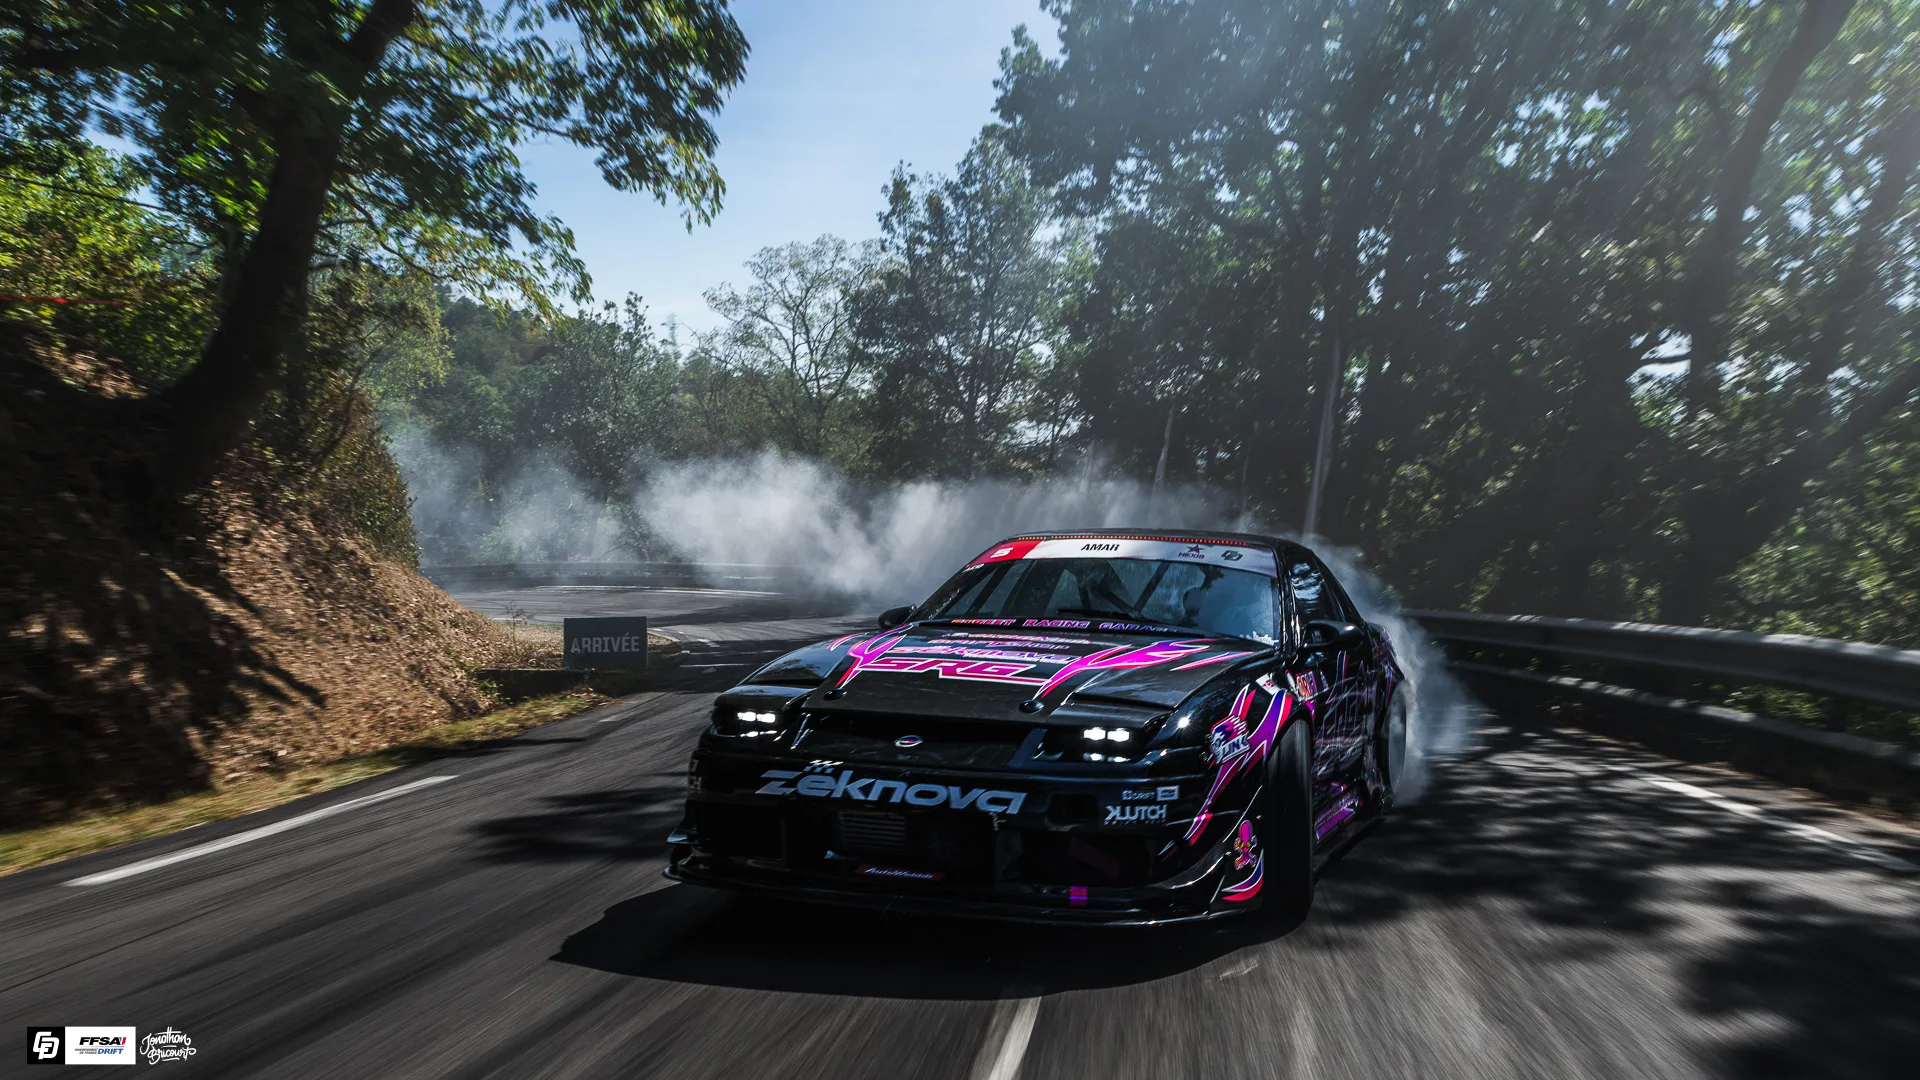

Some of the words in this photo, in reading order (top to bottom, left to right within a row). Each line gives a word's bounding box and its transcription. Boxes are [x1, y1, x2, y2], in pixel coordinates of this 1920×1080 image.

[1081, 543, 1120, 552] AMAR
[1022, 619, 1090, 629] RACING
[570, 632, 640, 653] ARRIVÉE
[861, 657, 1046, 684] SRG
[1105, 804, 1167, 820] KLUTCH
